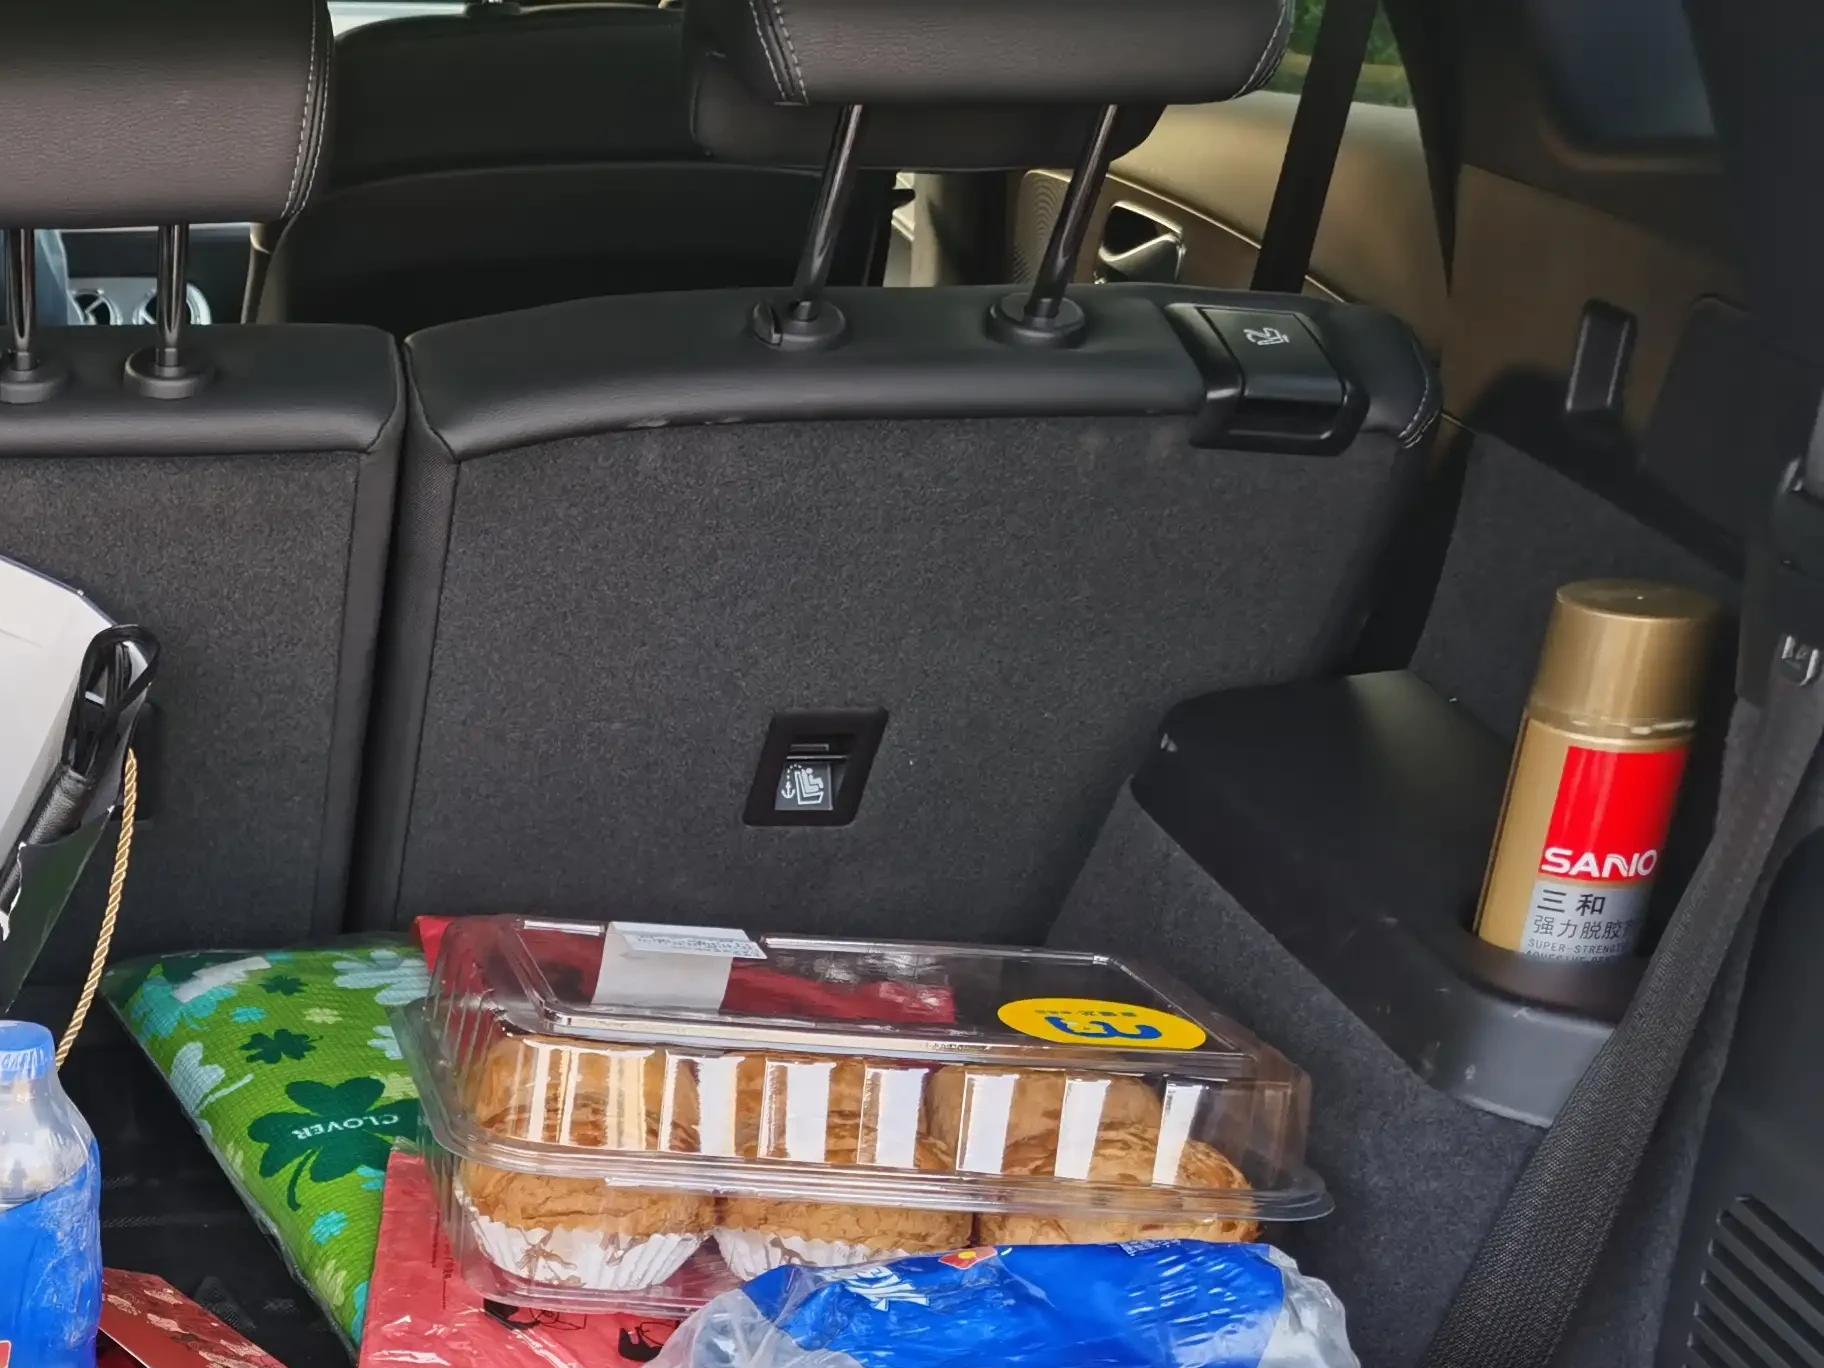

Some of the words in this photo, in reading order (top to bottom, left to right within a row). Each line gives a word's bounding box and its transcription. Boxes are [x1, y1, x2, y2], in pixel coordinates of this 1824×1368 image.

[1541, 846, 1658, 878] SANO
[1537, 889, 1606, 916] 三和
[292, 1114, 399, 1140] CLOVER
